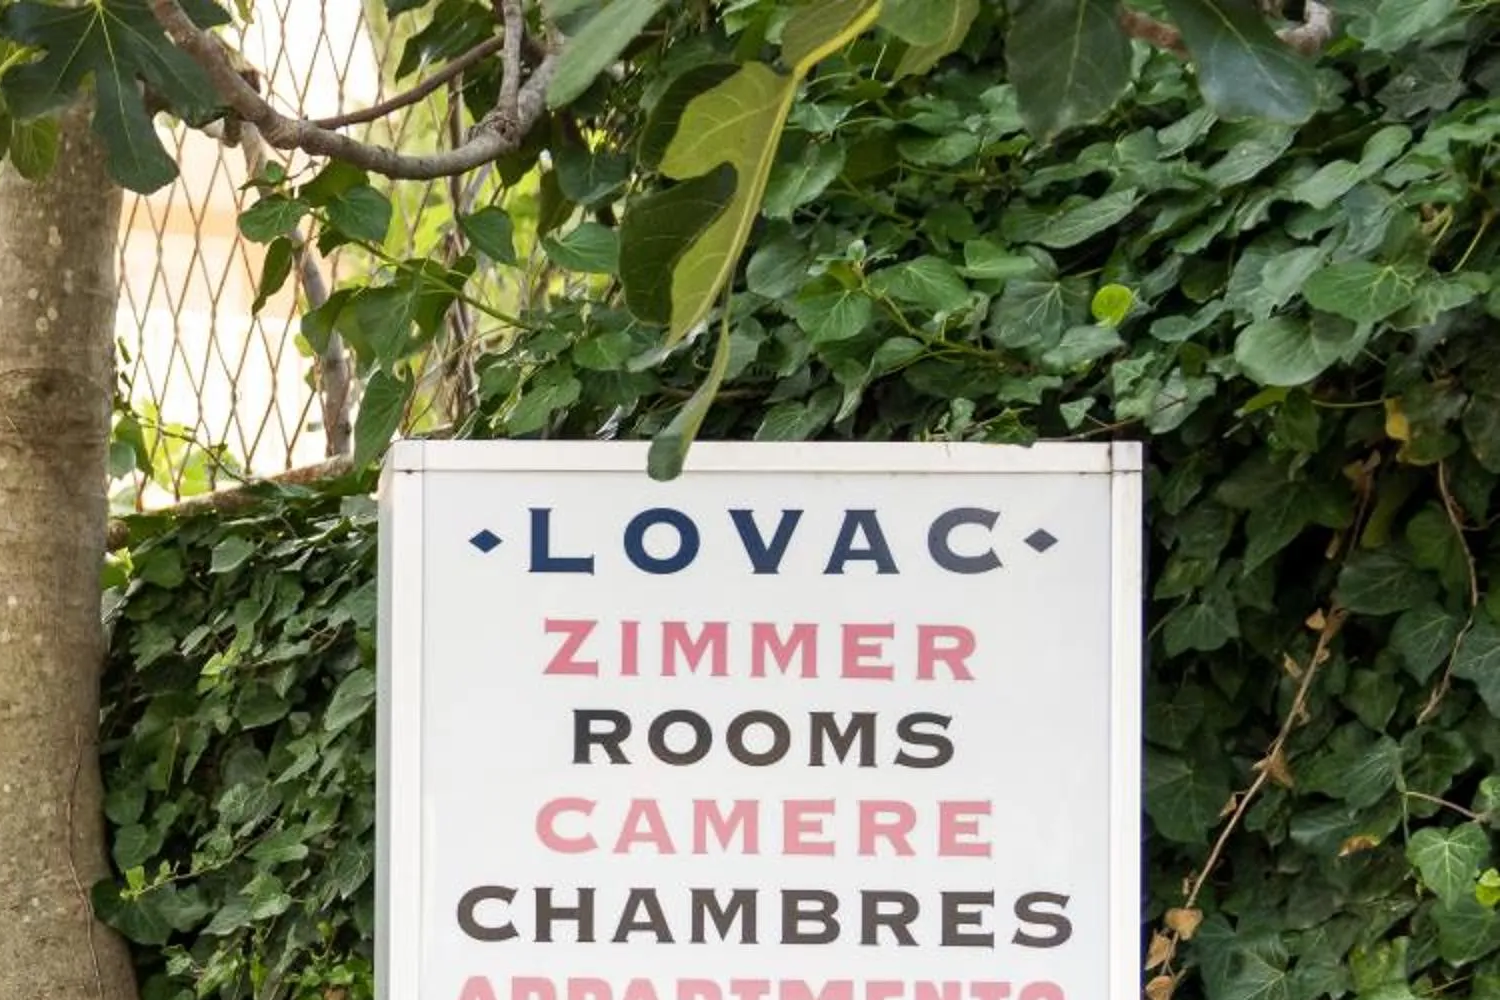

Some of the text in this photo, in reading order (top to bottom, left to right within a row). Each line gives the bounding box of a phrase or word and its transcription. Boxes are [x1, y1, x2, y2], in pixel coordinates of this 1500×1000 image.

[527, 507, 1005, 576] LOVAC
[542, 618, 977, 681] ZIMMER
[572, 708, 955, 769] ROOMS
[535, 796, 994, 857] CAMERE
[456, 884, 1073, 949] CHAMBRES
